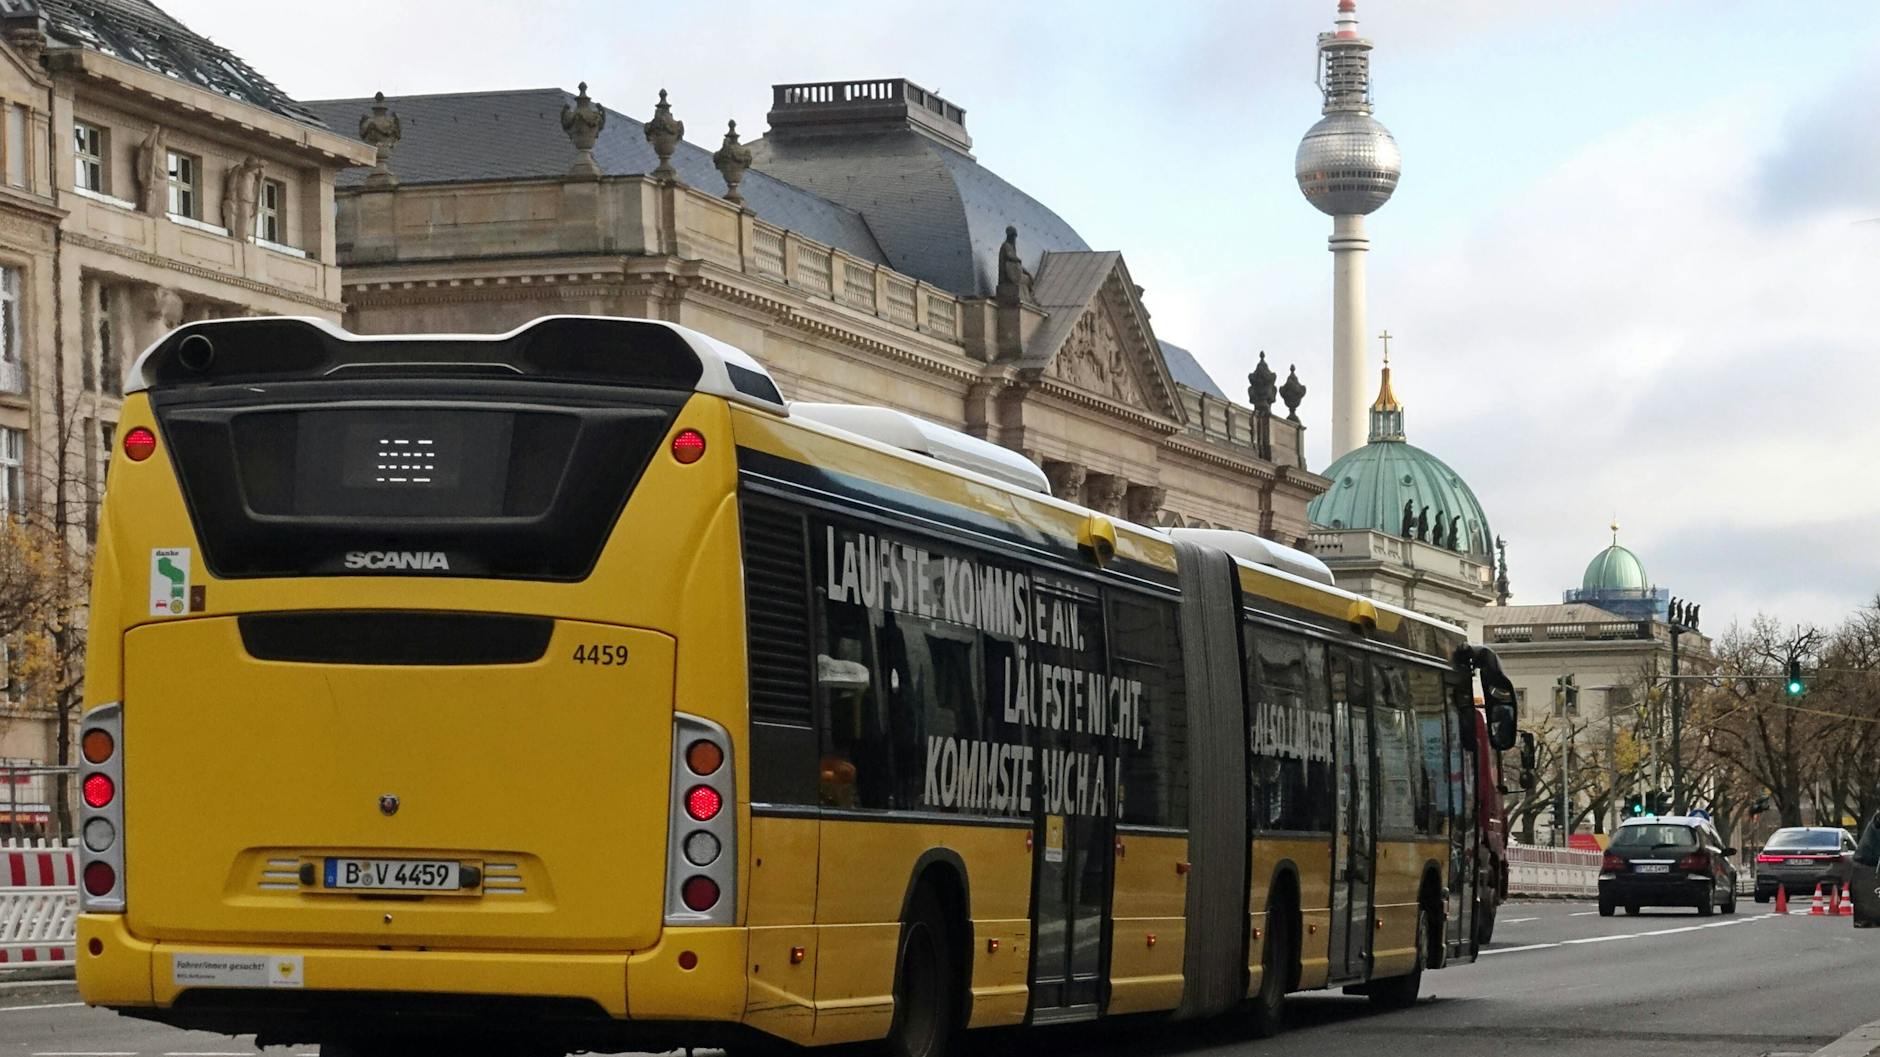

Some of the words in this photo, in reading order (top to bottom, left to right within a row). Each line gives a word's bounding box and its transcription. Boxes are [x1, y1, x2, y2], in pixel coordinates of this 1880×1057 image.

[344, 551, 449, 570] SCANIA
[573, 644, 628, 666] 4459
[924, 735, 1034, 811] KOMMSTE
[346, 862, 360, 884] B
[376, 864, 389, 884] V
[395, 864, 449, 886] 4459
[229, 962, 265, 971] gesucht!
